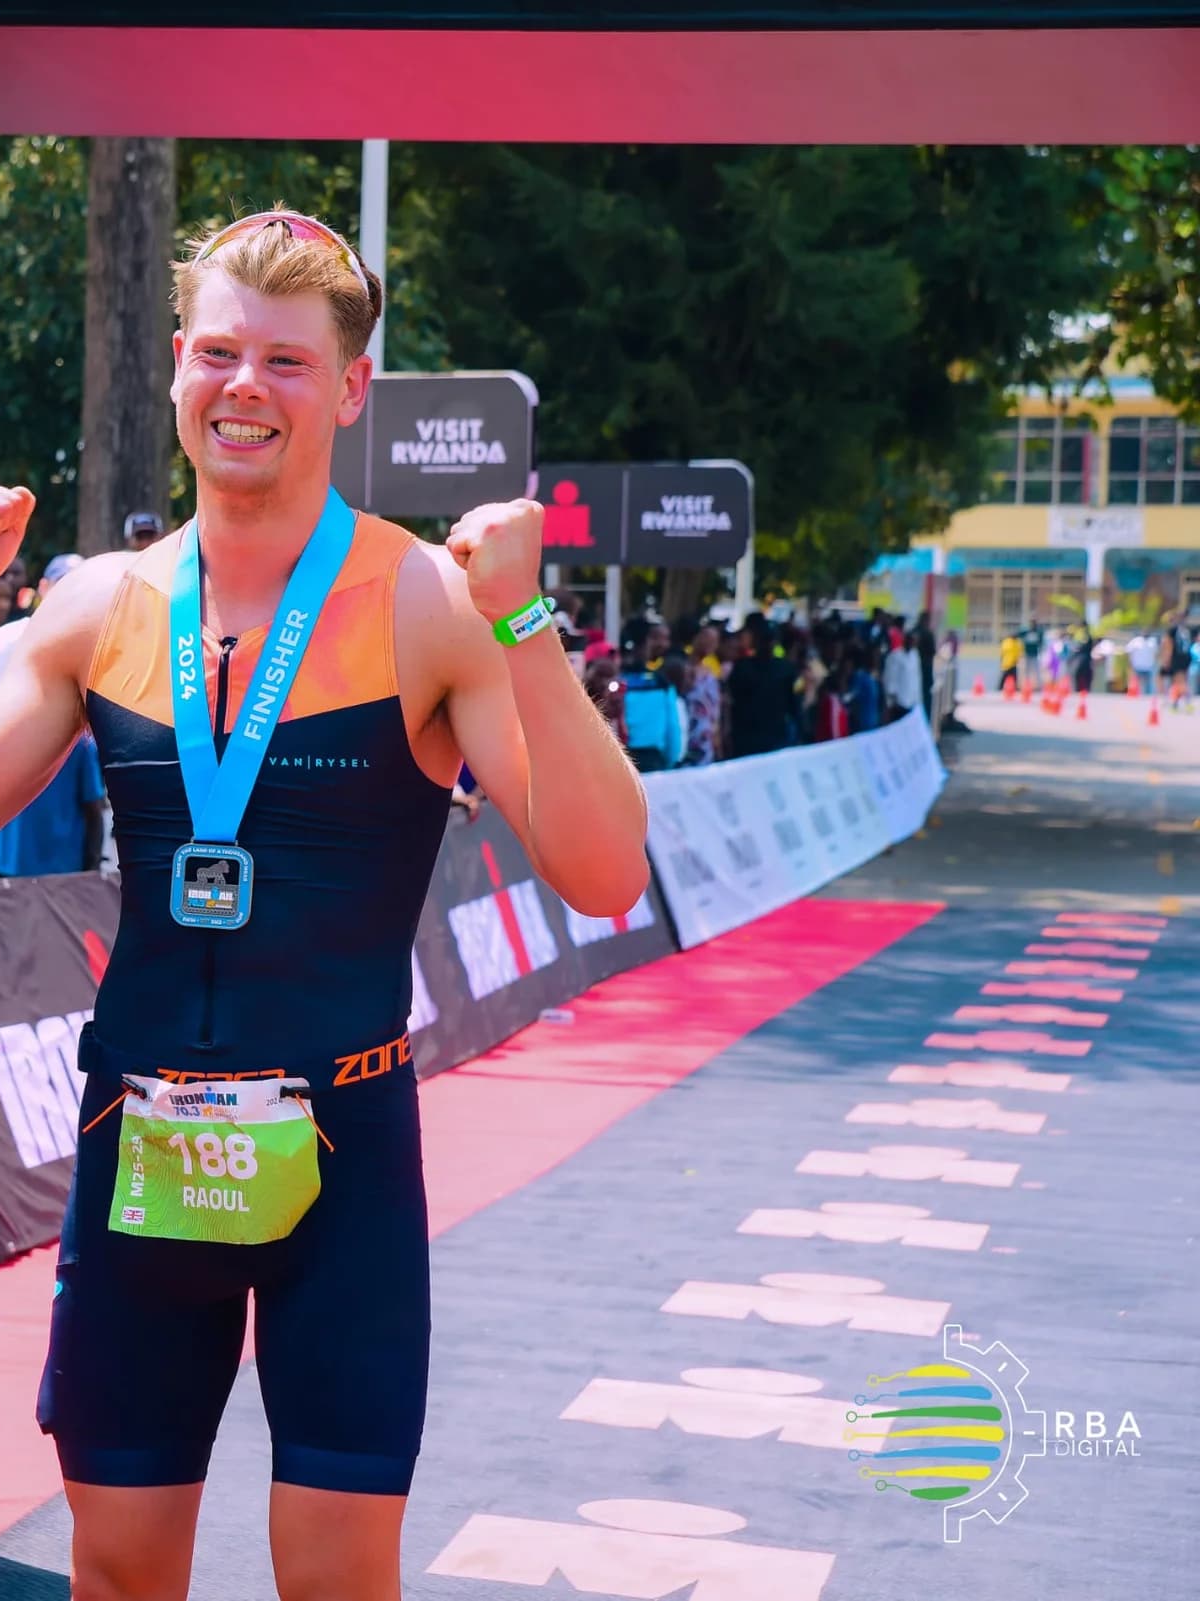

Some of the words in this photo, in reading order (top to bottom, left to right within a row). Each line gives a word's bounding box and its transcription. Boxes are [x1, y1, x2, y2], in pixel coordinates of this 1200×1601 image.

[415, 418, 483, 441] VISIT
[391, 440, 506, 464] RWANDA
[661, 495, 714, 513] VISIT
[641, 511, 732, 531] RWANDA
[178, 633, 197, 700] 2024
[243, 608, 309, 741] FINISHER
[169, 1086, 238, 1106] IRONMAN
[173, 1106, 200, 1117] 70.3
[168, 1132, 258, 1179] 188
[183, 1186, 250, 1212] RAOUL
